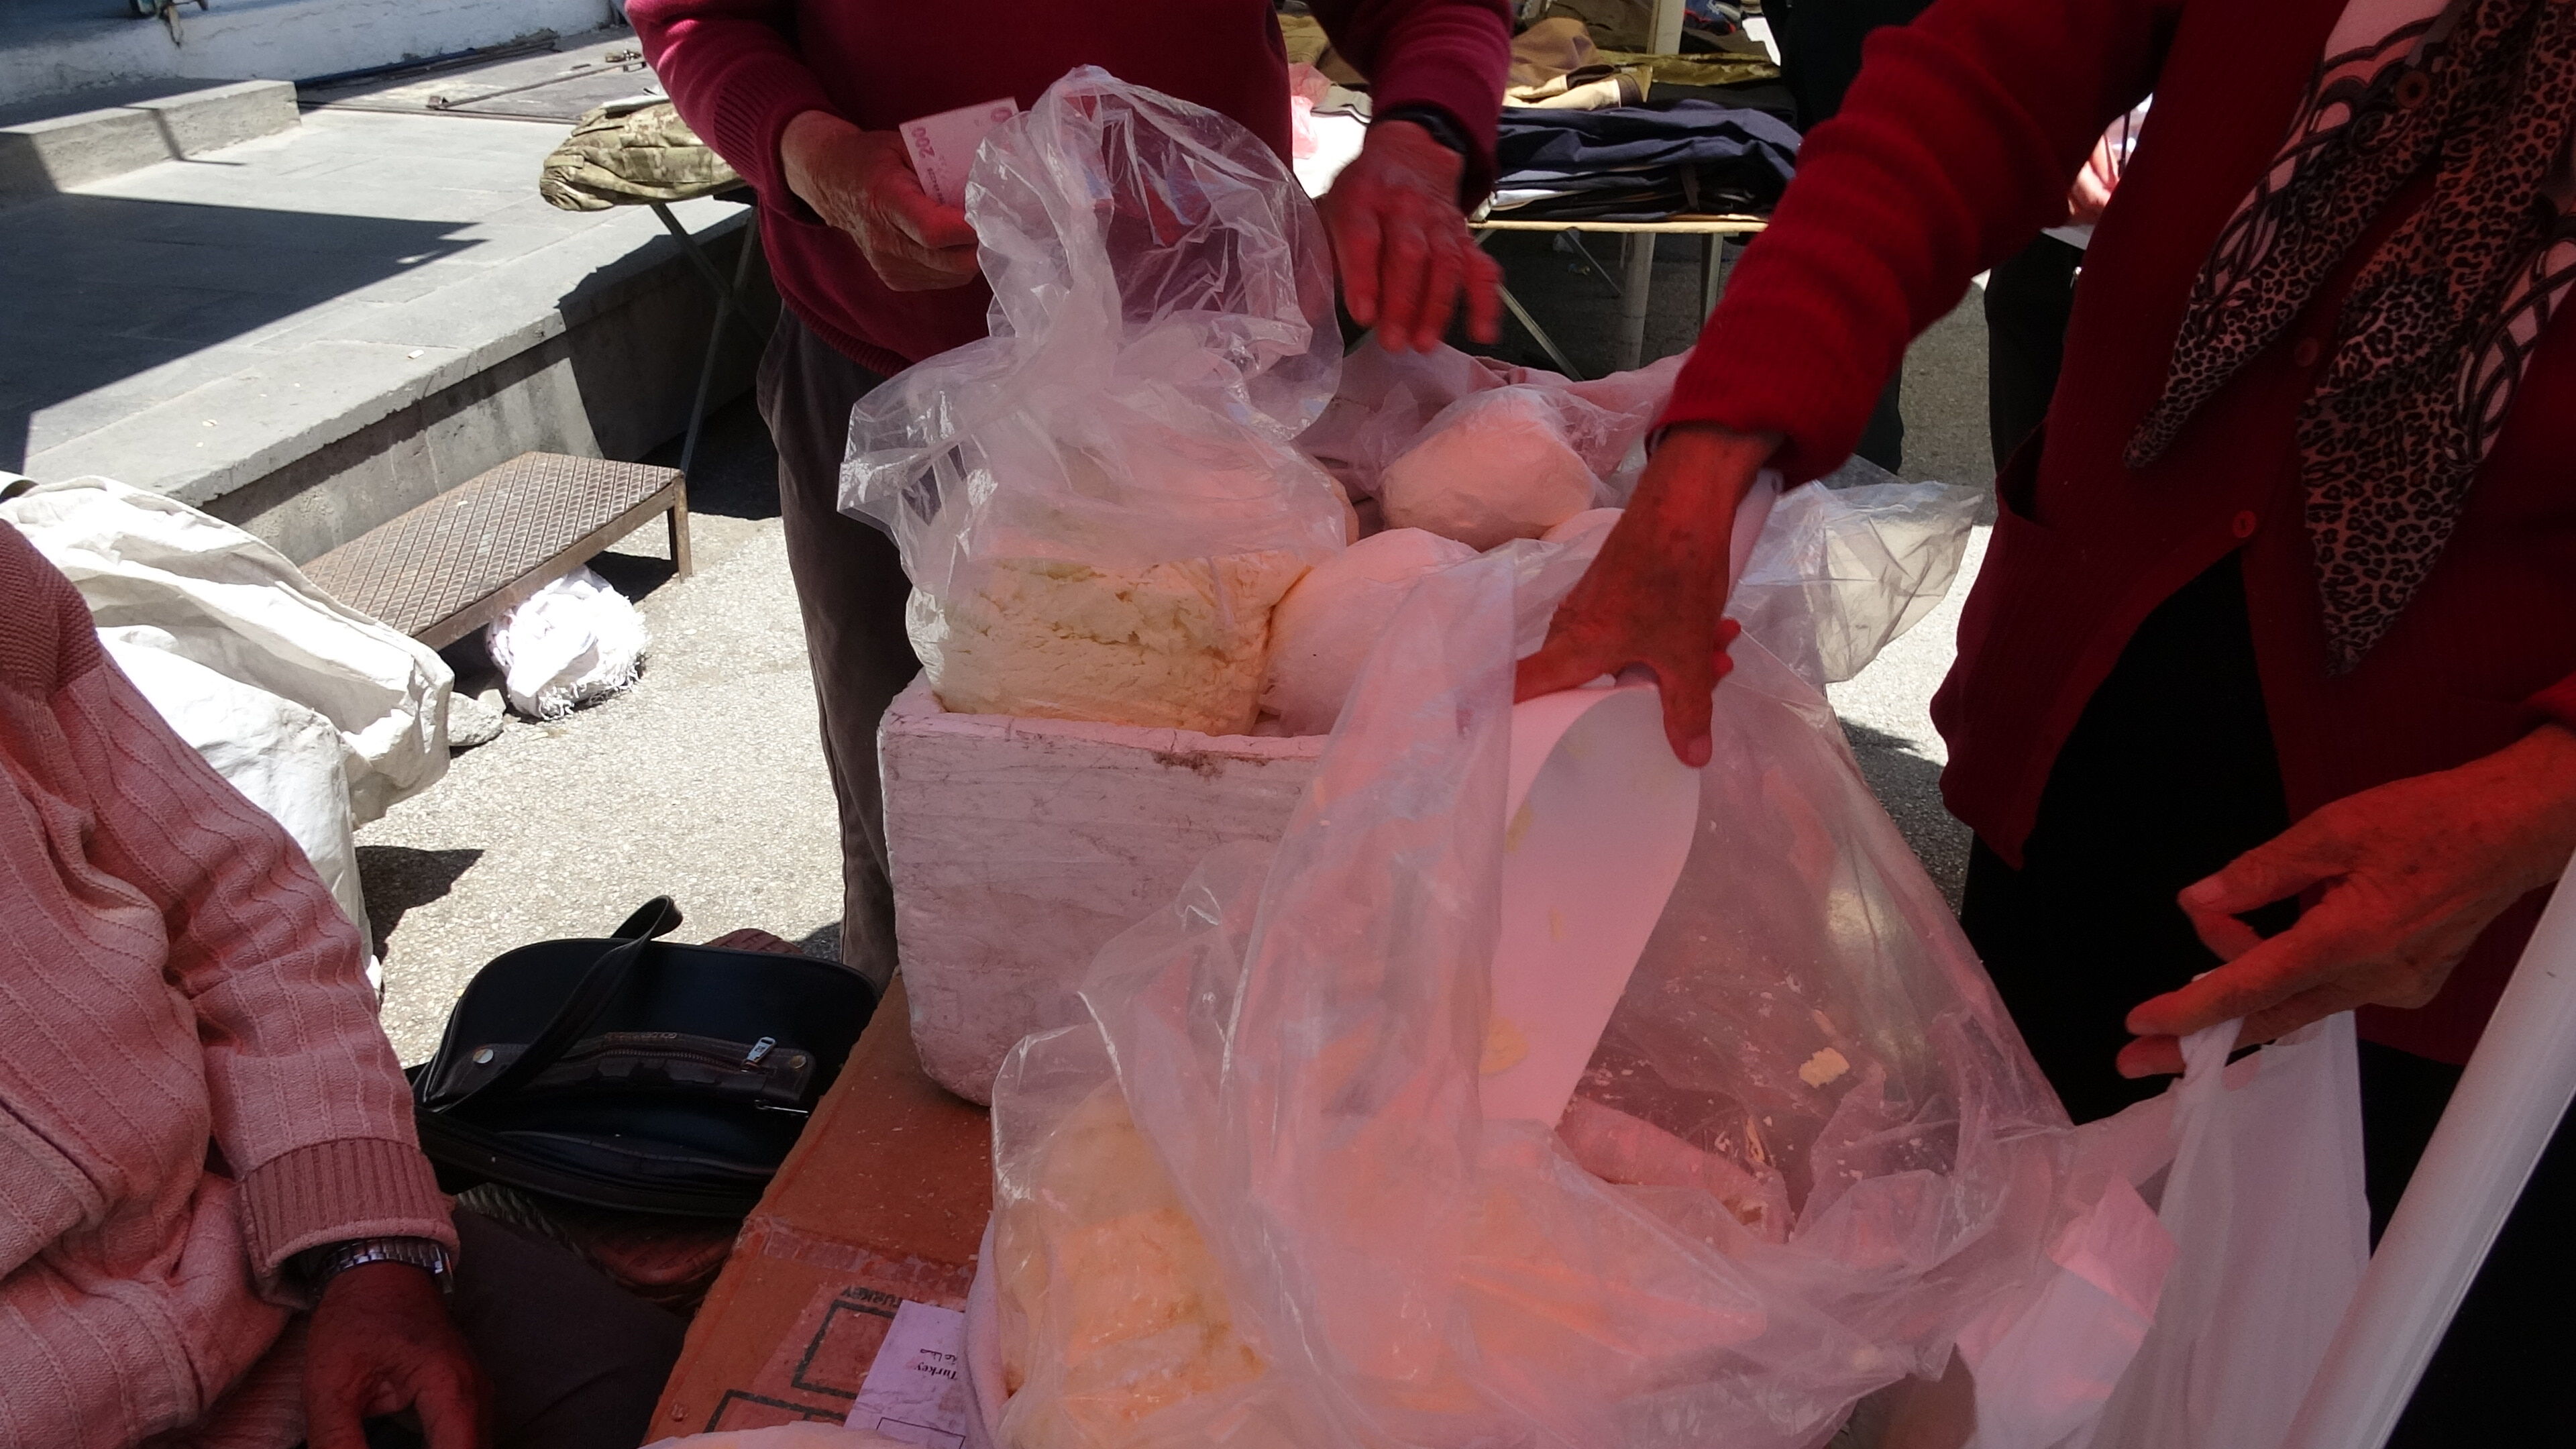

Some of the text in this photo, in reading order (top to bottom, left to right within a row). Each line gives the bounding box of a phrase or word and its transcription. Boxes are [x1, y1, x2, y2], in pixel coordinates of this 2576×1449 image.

[911, 127, 935, 159] 200
[920, 1348, 957, 1365] صناعة
[914, 1362, 957, 1381] Turkey
